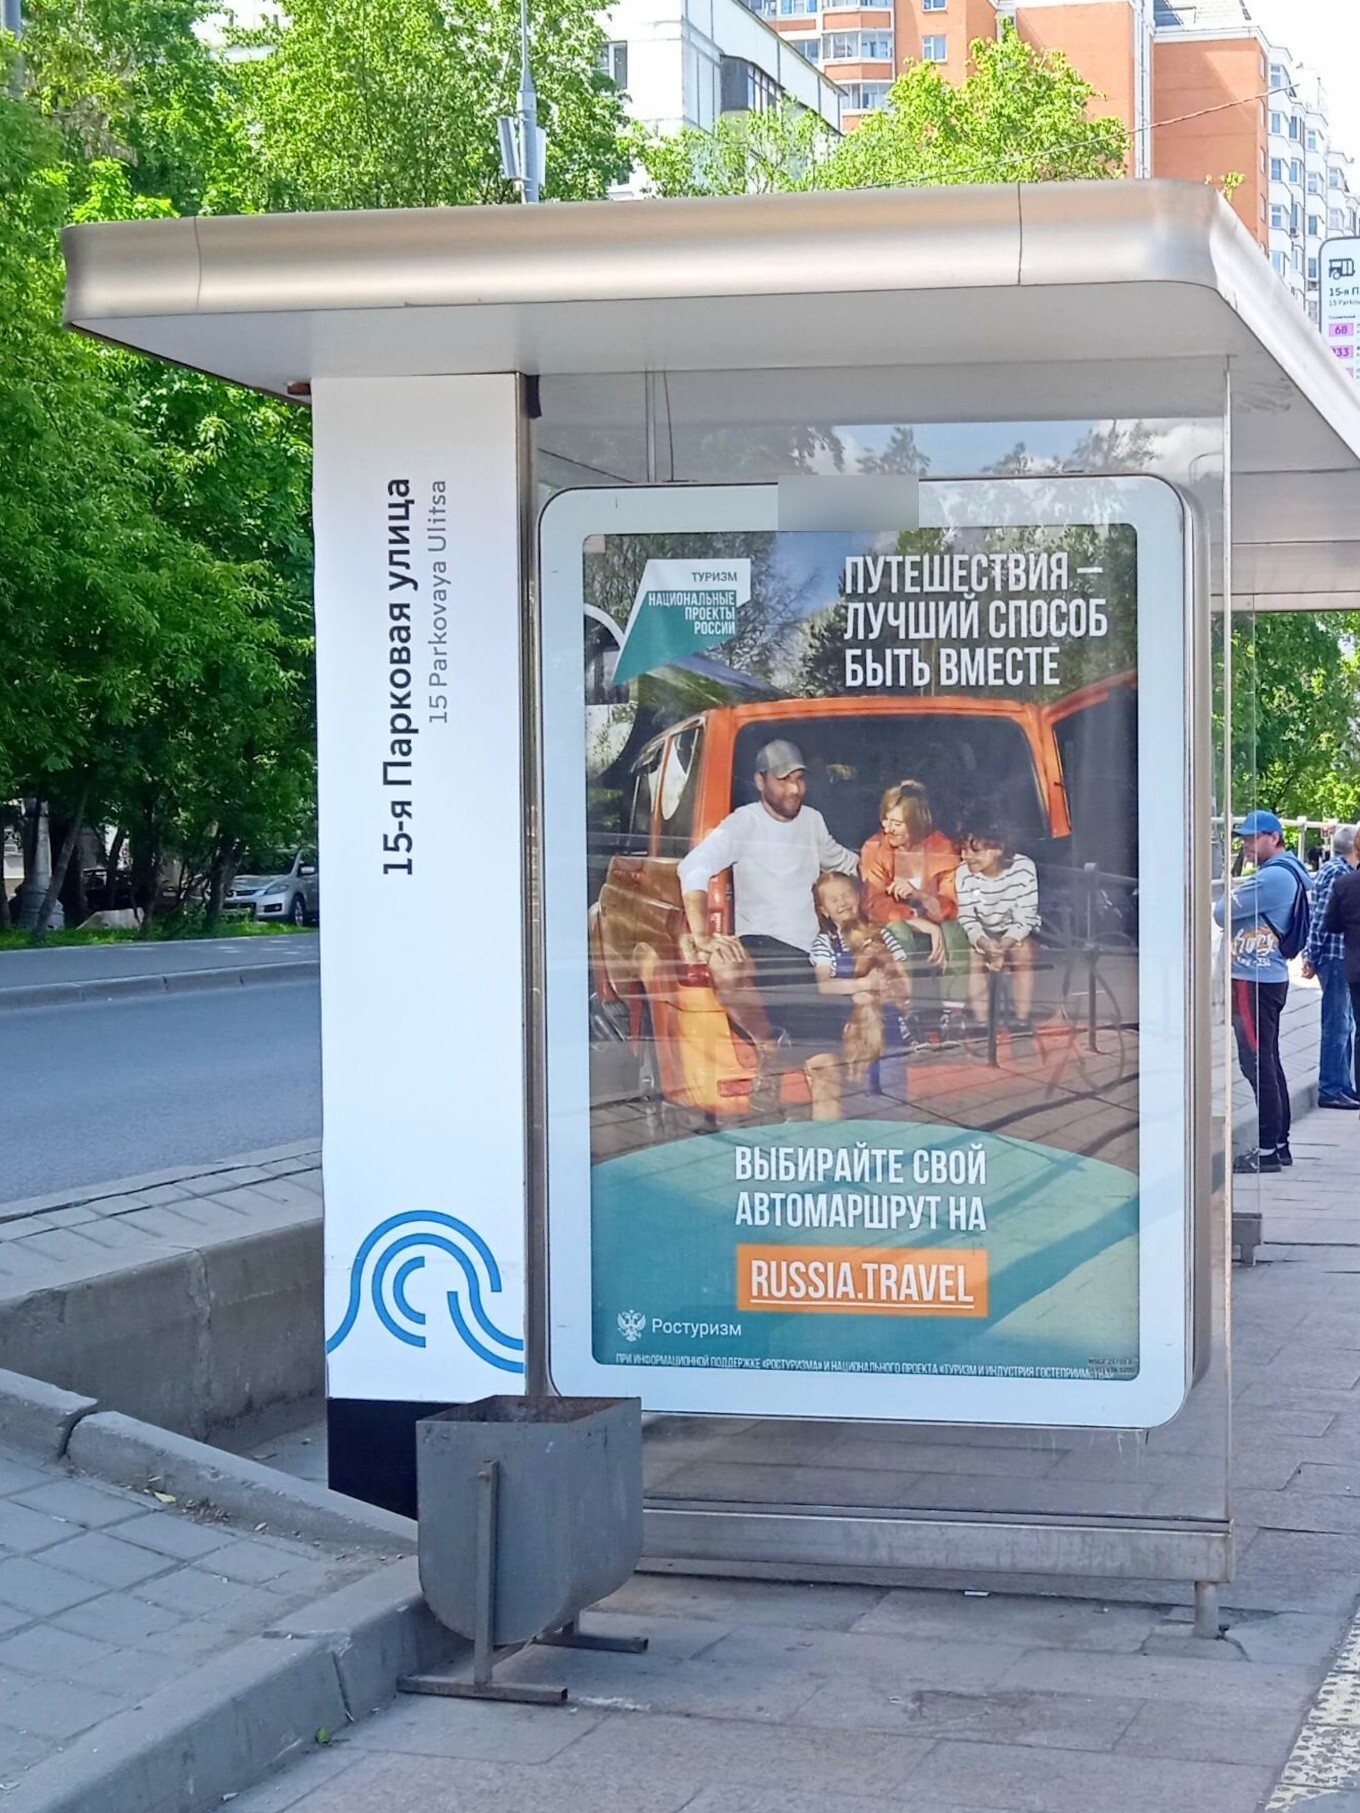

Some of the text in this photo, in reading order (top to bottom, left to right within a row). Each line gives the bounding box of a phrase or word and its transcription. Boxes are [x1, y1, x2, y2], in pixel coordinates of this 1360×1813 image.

[1329, 287, 1350, 297] 15-я
[1334, 325, 1348, 335] 68
[691, 572, 738, 582] ТУРИЗМ
[845, 552, 1069, 595] ПУТЕШЕСТВИЯ
[427, 480, 451, 724] 15 Parkovaya Ulitsa
[648, 592, 735, 607] НАЦИОНАЛЬНЫЕ
[684, 606, 735, 621] ПРОЕКТЫ
[693, 621, 736, 635] РОССИИ
[843, 592, 1108, 640] ЛУЧШИЙ СПОСОБ
[383, 479, 419, 876] 15-я Парковая улица
[845, 646, 1061, 687] БЫТЬ ВМЕСТЕ
[735, 1141, 986, 1185] ВЫБИРАЙТЕ СВОЙ
[735, 1191, 987, 1231] АВТОМАРШРУТ НА
[751, 1259, 975, 1303] RUSSIA.TRAVEL
[651, 1318, 742, 1339] Ростуризм
[615, 1353, 632, 1364] ПРИ
[633, 1354, 710, 1367] ИНФОРМАЦИОННОЙ
[710, 1356, 761, 1369] ПОДДЕРЖКЕ
[831, 1361, 901, 1374] НАЦИОНАЛЬНОГО
[902, 1363, 938, 1374] ПРОЕКТА
[985, 1365, 1034, 1377] ИНДУСТРИЯ
